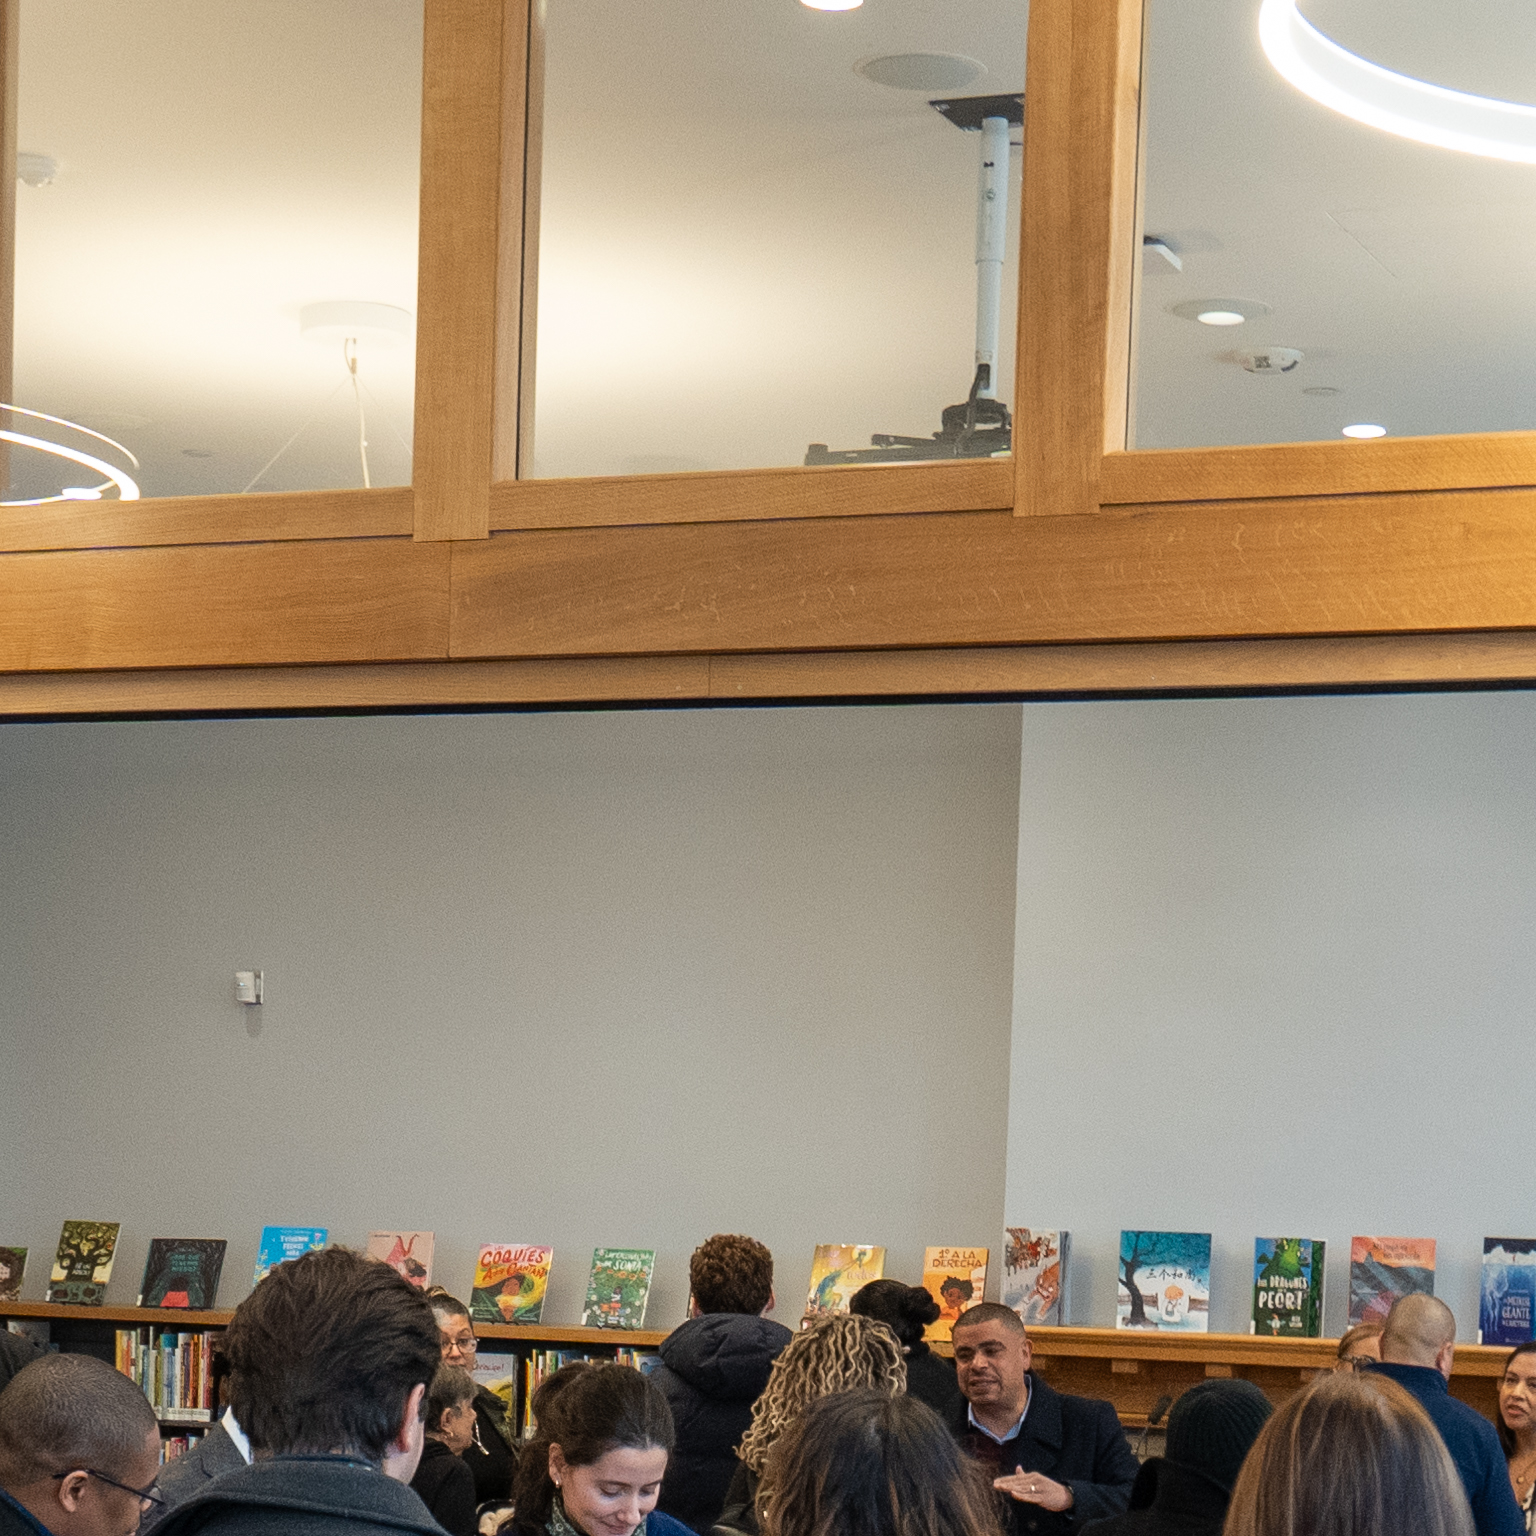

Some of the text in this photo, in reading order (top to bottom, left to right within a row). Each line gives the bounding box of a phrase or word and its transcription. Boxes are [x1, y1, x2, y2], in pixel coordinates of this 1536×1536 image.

[952, 1250, 960, 1259] A
[962, 1250, 976, 1259] LA
[932, 1258, 983, 1269] DERECHA
